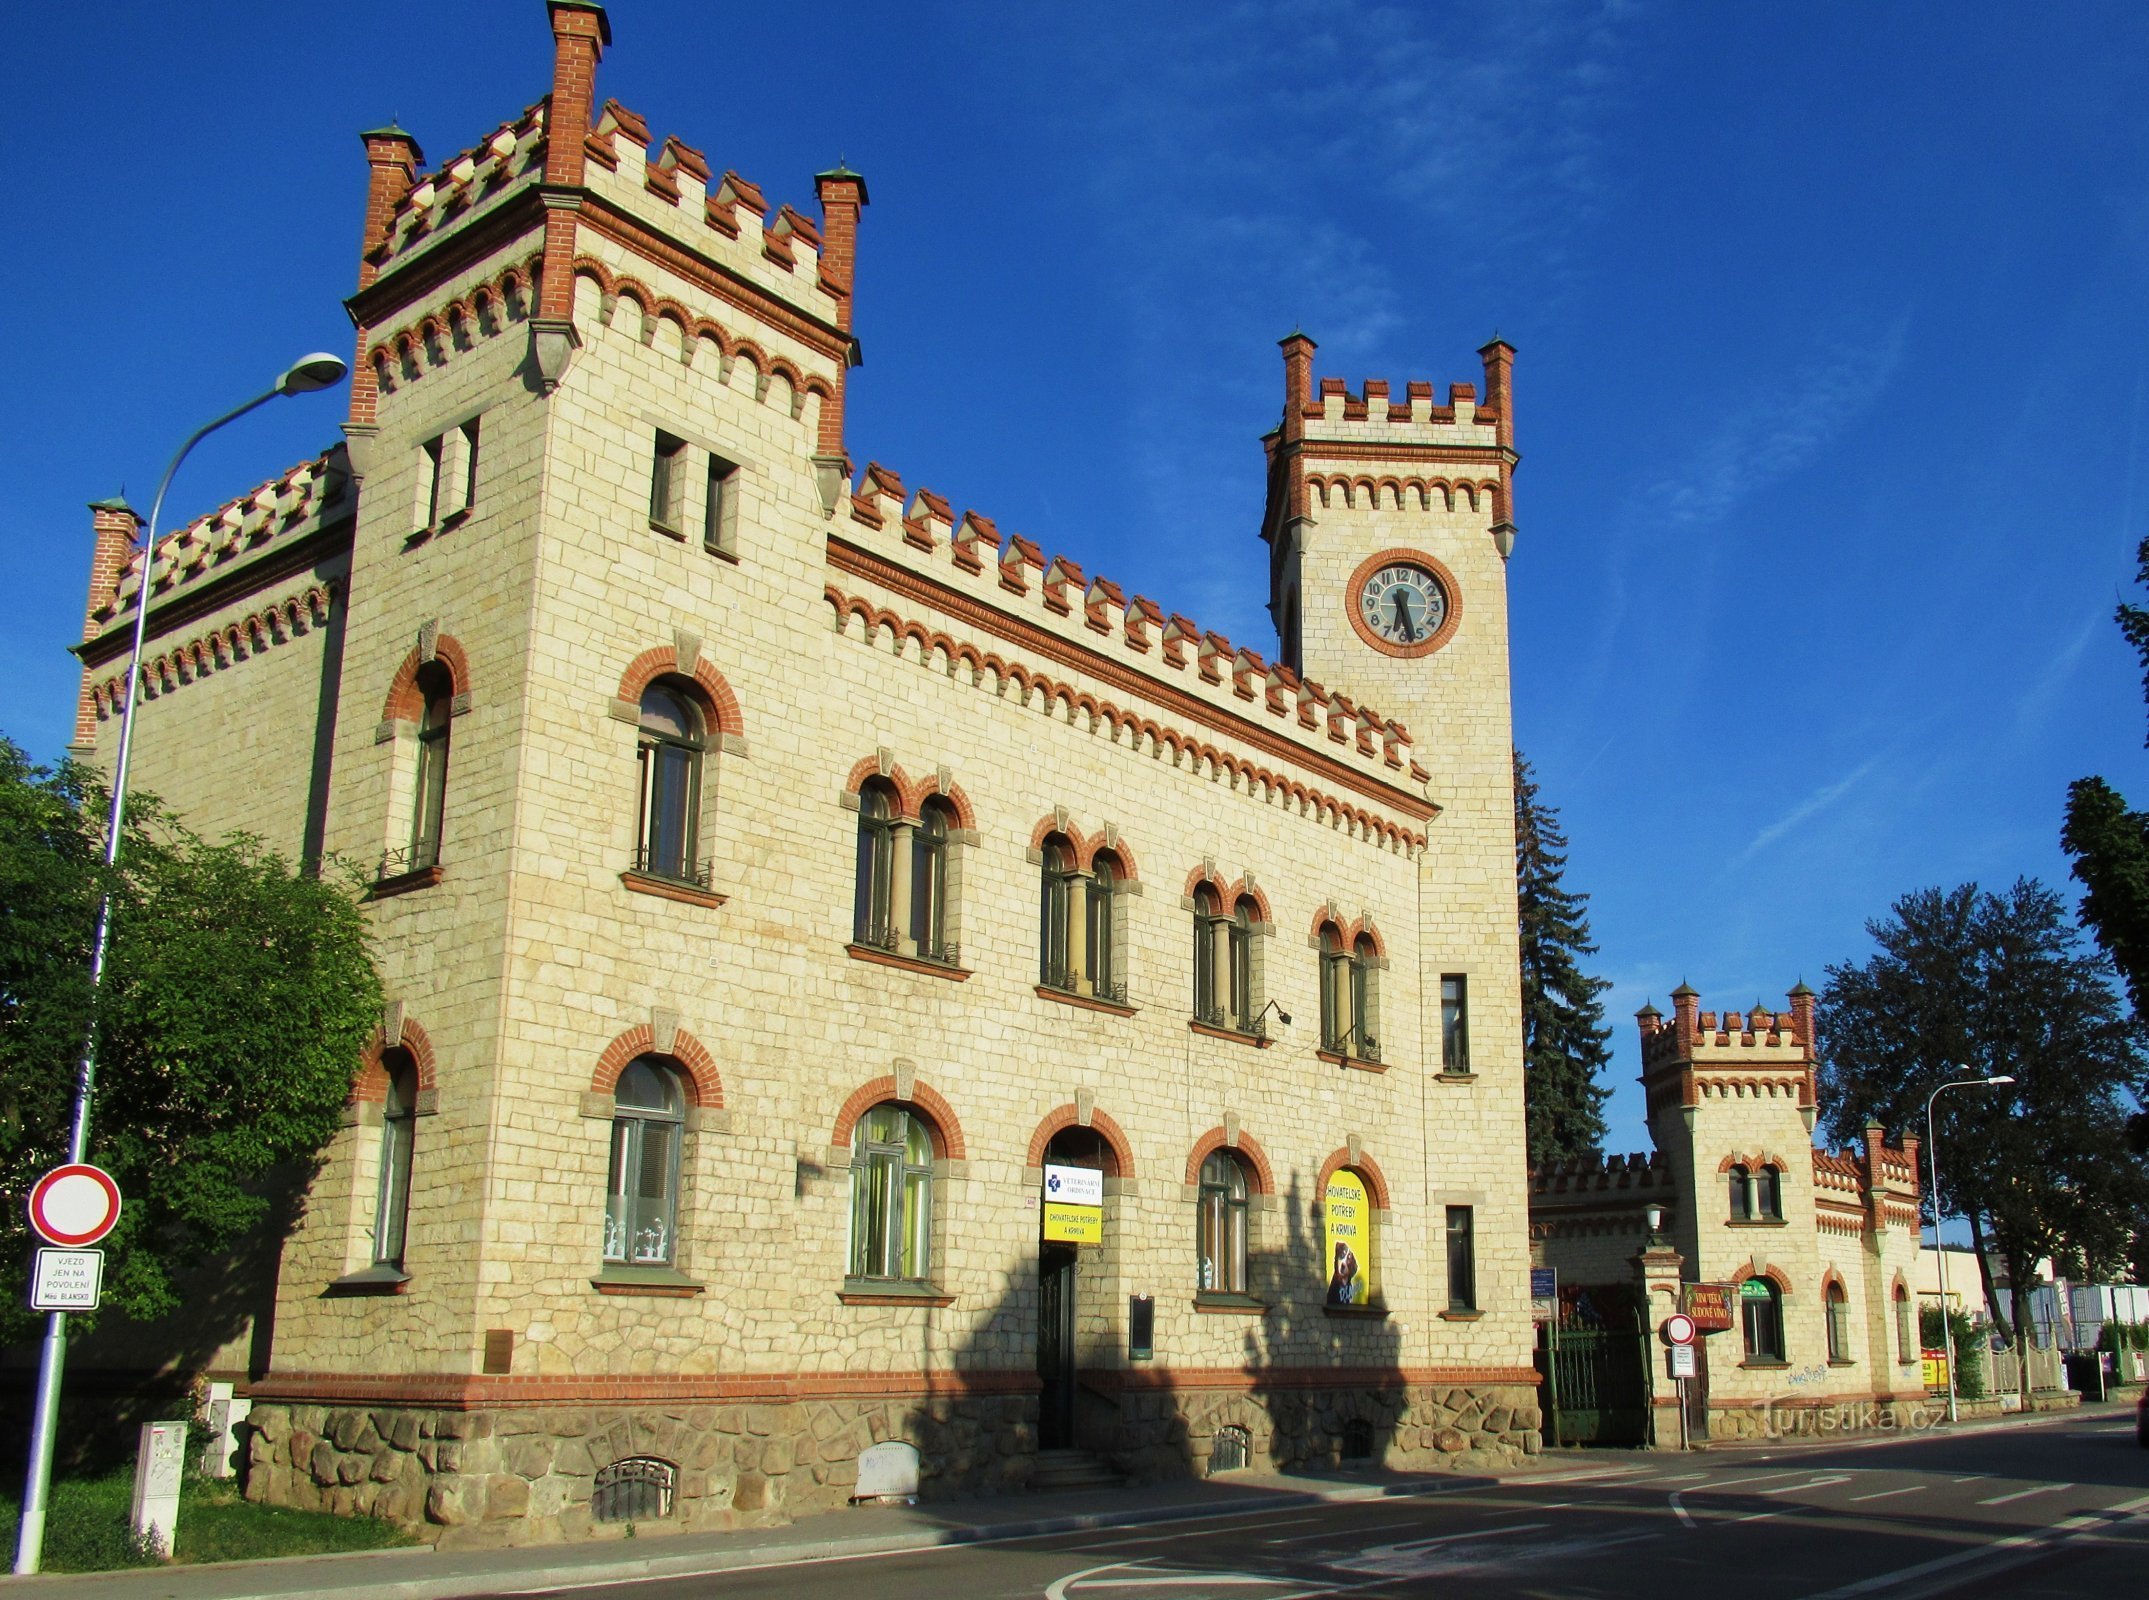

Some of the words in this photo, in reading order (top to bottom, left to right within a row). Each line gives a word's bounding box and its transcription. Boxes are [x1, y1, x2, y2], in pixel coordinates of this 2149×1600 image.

[1382, 572, 1390, 585] 11
[1396, 569, 1408, 581] 12
[1416, 574, 1421, 585] 1
[1368, 583, 1380, 595] 10
[1427, 585, 1436, 596] 2
[1366, 598, 1375, 610] 9
[1430, 601, 1440, 612] 3
[1370, 615, 1380, 626] 8
[1426, 616, 1436, 628] 4
[1383, 626, 1392, 637] 7
[1399, 631, 1407, 642] 6
[1416, 628, 1424, 639] 5
[1331, 1203, 1356, 1218] POTŘEBY
[1330, 1222, 1335, 1234] A
[1336, 1224, 1357, 1237] KRMIVA
[52, 1269, 69, 1277] JEN
[46, 1280, 90, 1288] POVOLENÍ
[60, 1292, 89, 1301] BLANSKO
[1691, 1305, 1713, 1318] SUDOVÉ
[1713, 1306, 1727, 1318] VÍNO
